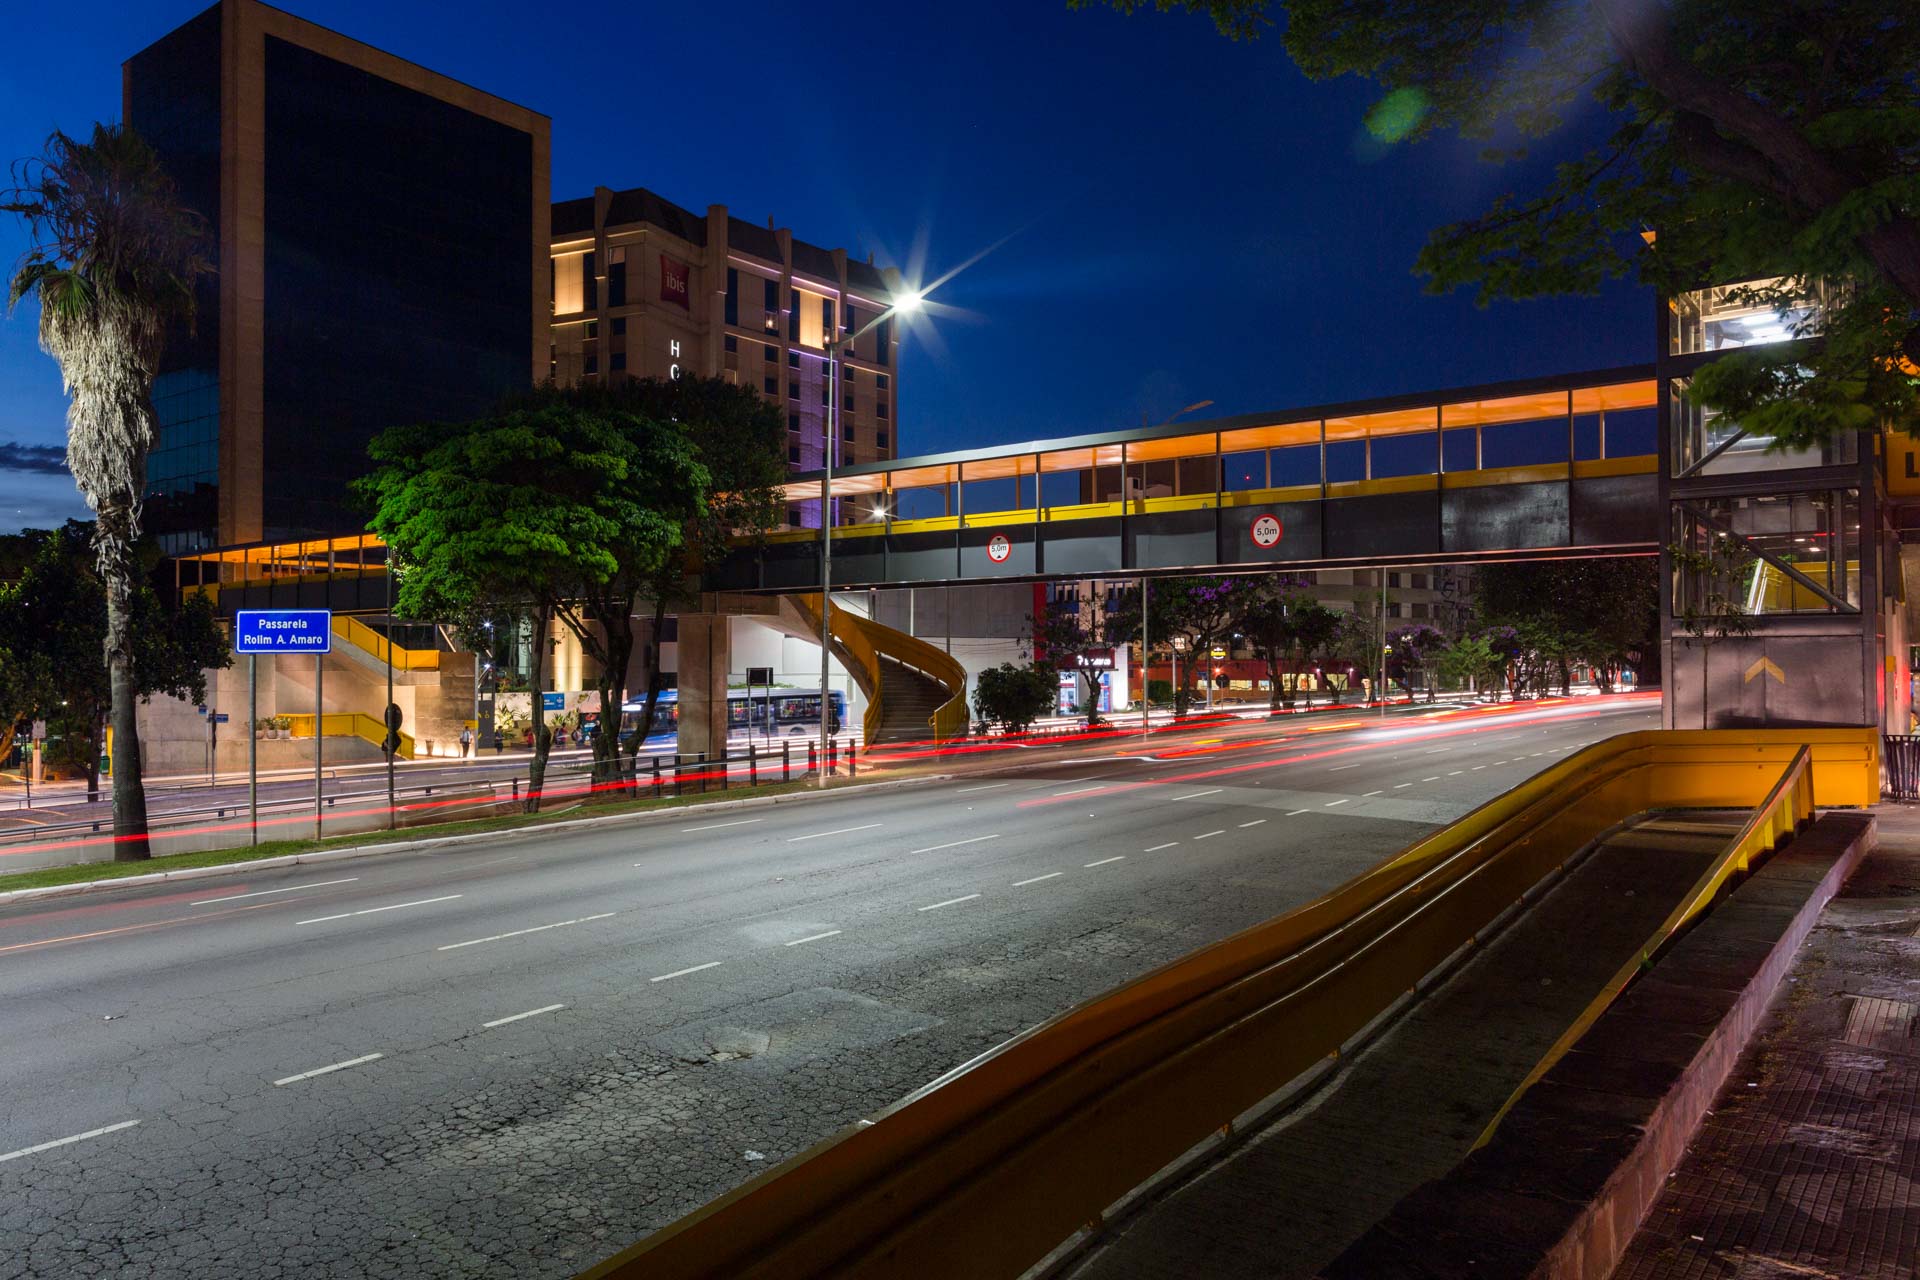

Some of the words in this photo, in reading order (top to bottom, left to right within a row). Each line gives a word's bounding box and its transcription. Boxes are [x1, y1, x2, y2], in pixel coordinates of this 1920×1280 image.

[666, 271, 685, 293] ibis
[1256, 527, 1277, 536] 5,0m
[258, 619, 308, 629] Passarela
[244, 634, 272, 645] Rolim
[289, 634, 323, 645] Amaro
